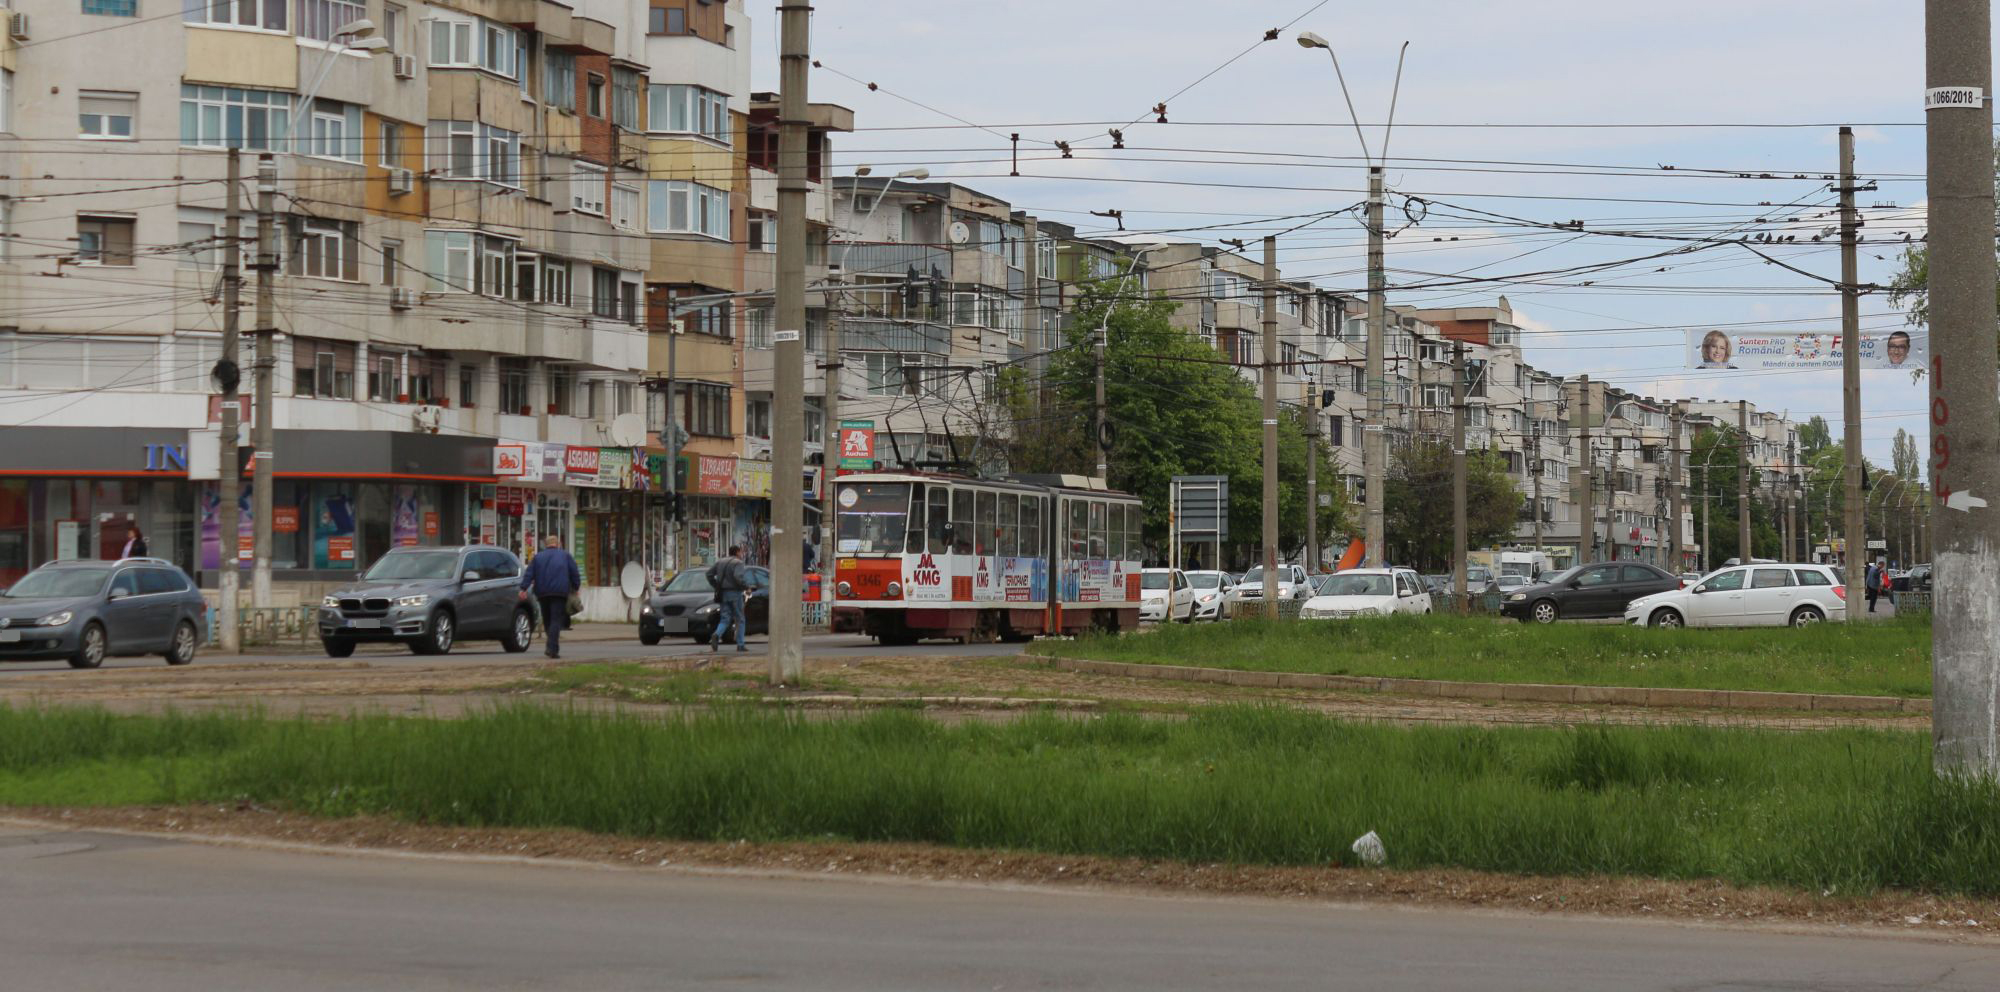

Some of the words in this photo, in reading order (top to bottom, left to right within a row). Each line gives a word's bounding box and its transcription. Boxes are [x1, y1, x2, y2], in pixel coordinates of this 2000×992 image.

[1933, 90, 1973, 104] 1066/2018
[1739, 337, 1768, 345] Suntem
[1858, 341, 1874, 349] RO
[1738, 346, 1785, 355] România!
[144, 443, 188, 470] IN
[702, 458, 732, 477] LIBRARIA
[913, 570, 941, 586] KMG
[976, 572, 989, 588] KMG
[1112, 574, 1123, 588] KMG
